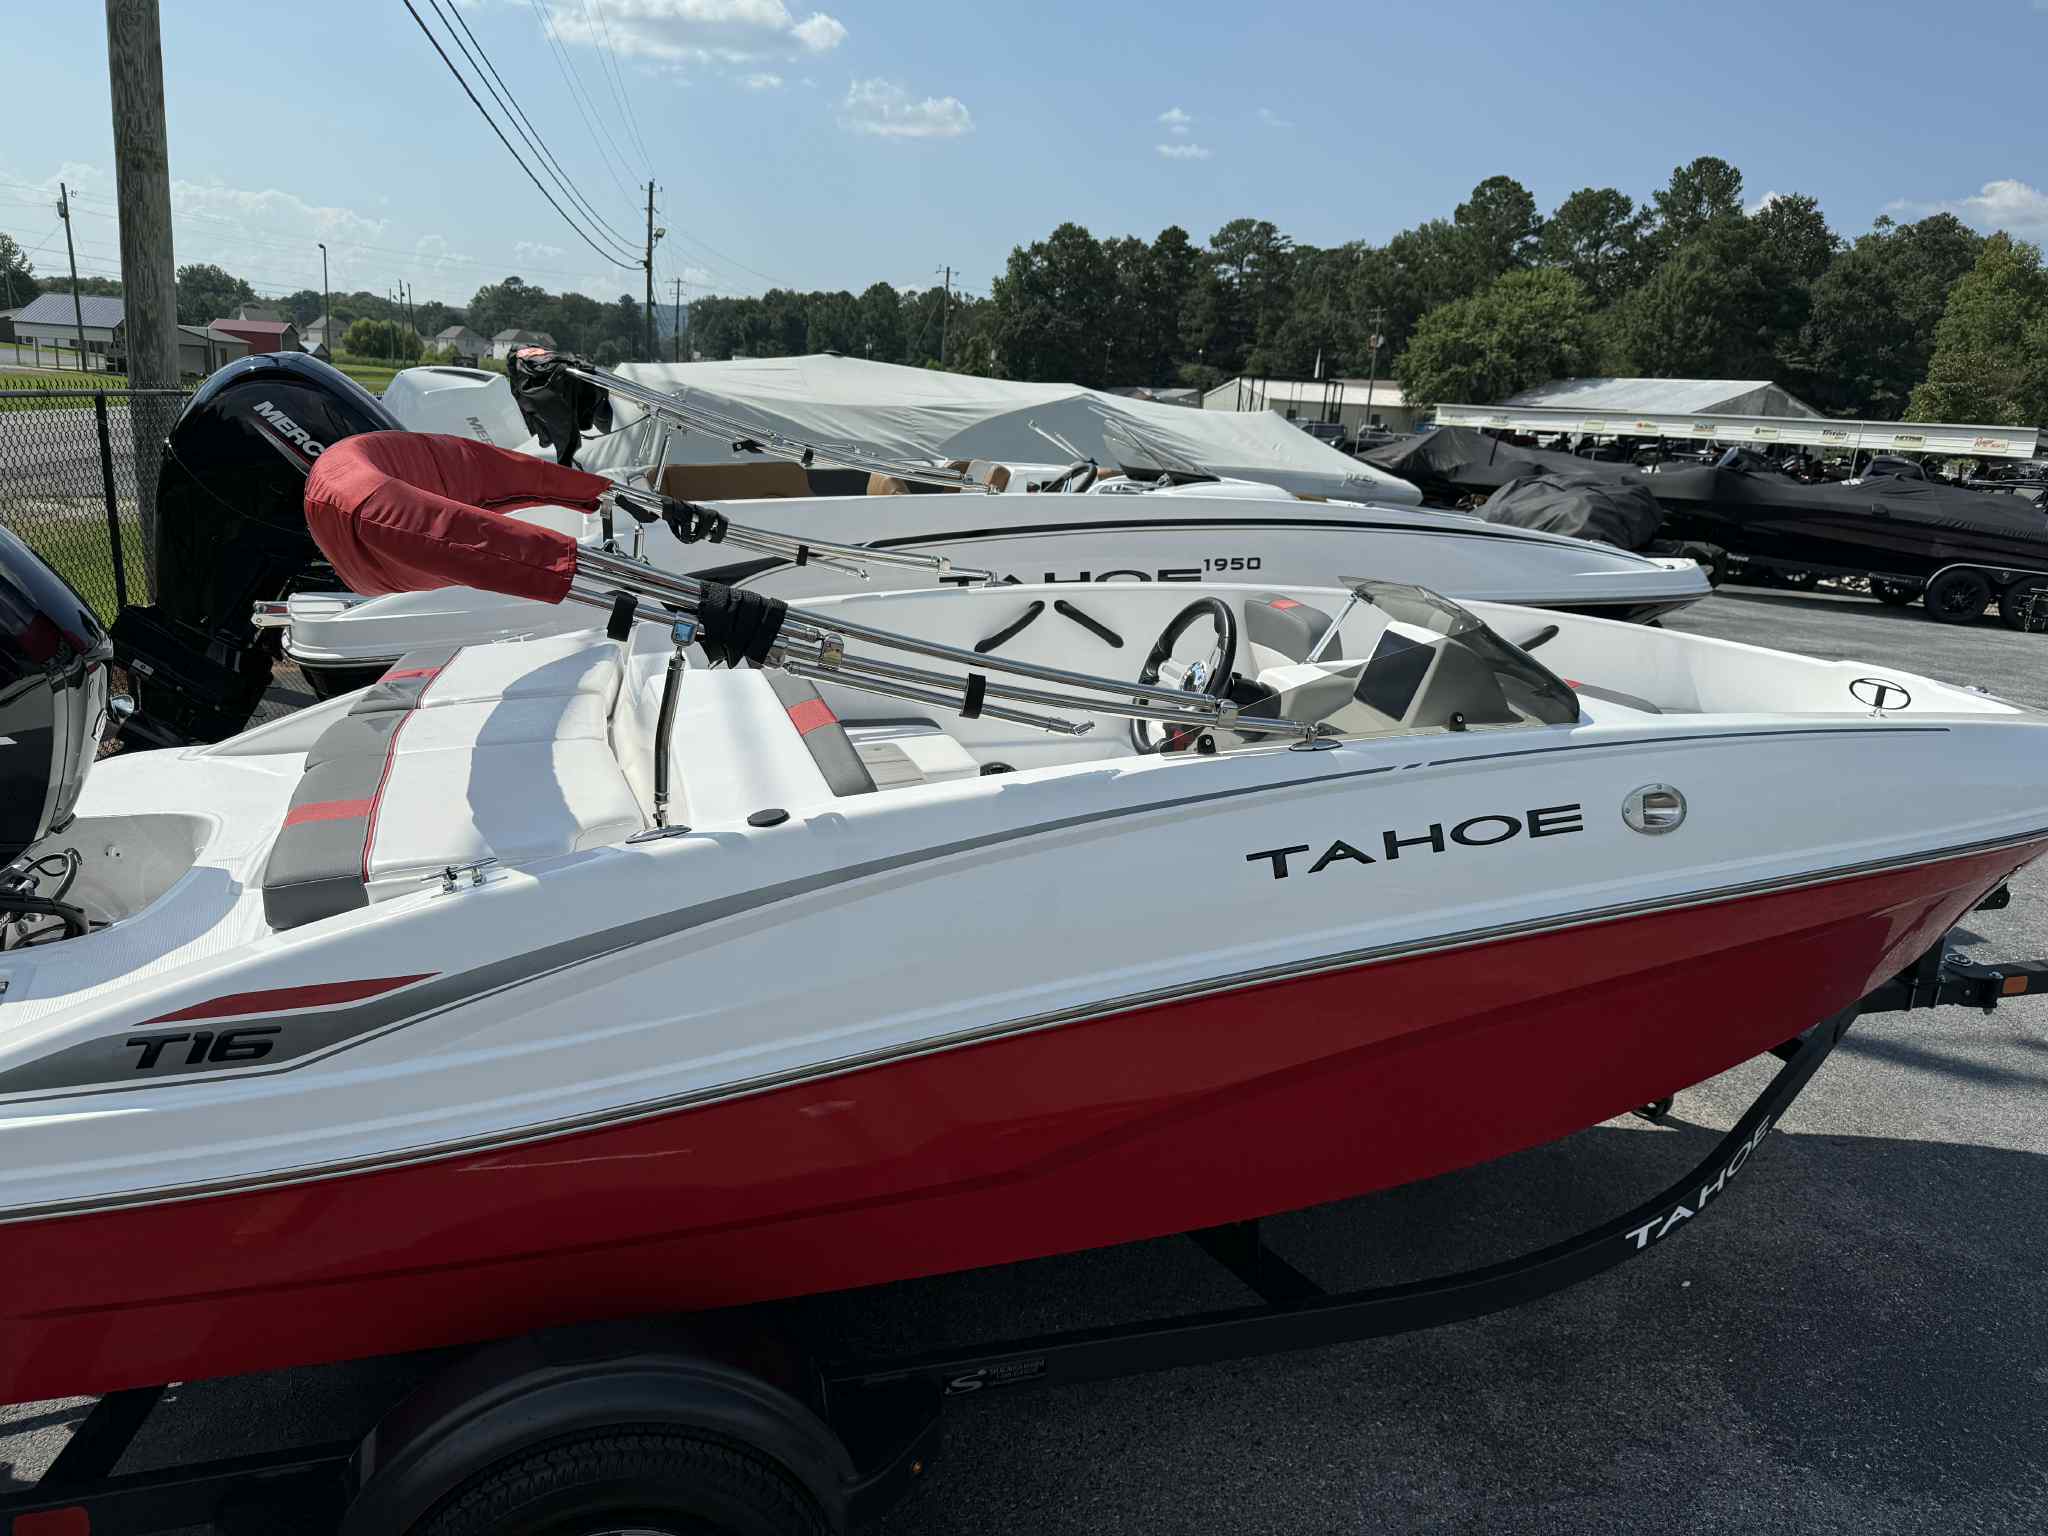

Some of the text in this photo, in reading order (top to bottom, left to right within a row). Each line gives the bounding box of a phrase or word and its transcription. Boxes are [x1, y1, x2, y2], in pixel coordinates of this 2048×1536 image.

[253, 400, 326, 456] MERC
[1203, 557, 1262, 571] 1950
[1246, 803, 1584, 880] TAHOE
[126, 1026, 282, 1070] T16
[1625, 1114, 1771, 1249] TAHOE
